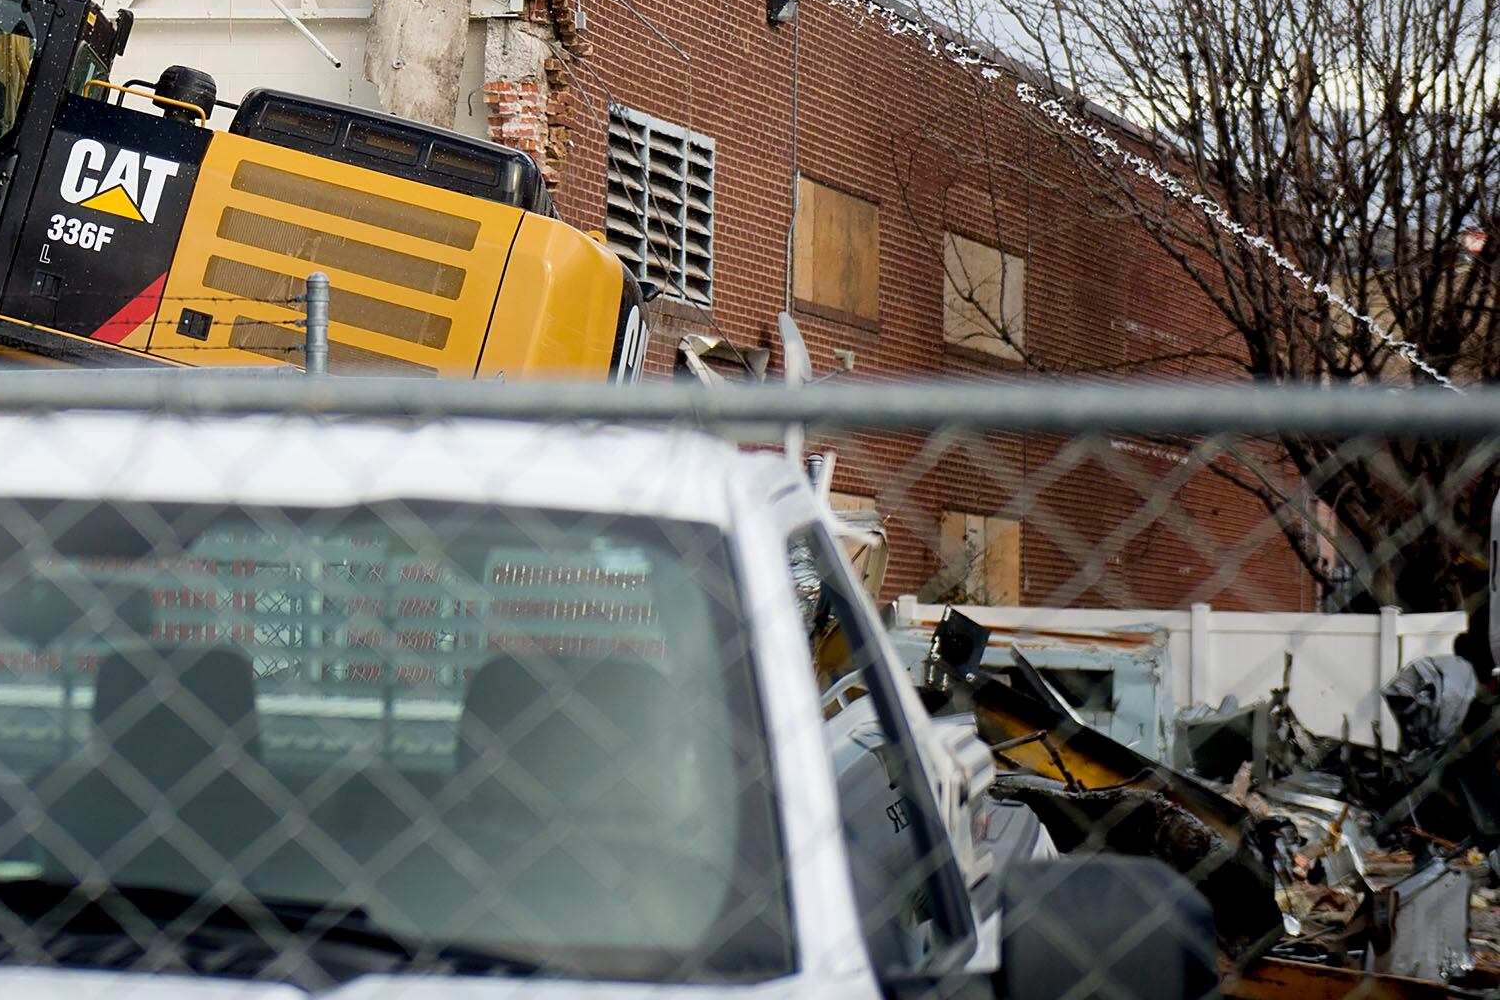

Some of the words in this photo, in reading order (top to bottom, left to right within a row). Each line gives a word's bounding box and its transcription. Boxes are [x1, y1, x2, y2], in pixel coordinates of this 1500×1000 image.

[60, 138, 180, 224] CAT
[47, 214, 114, 252] 336F
[39, 244, 50, 264] L
